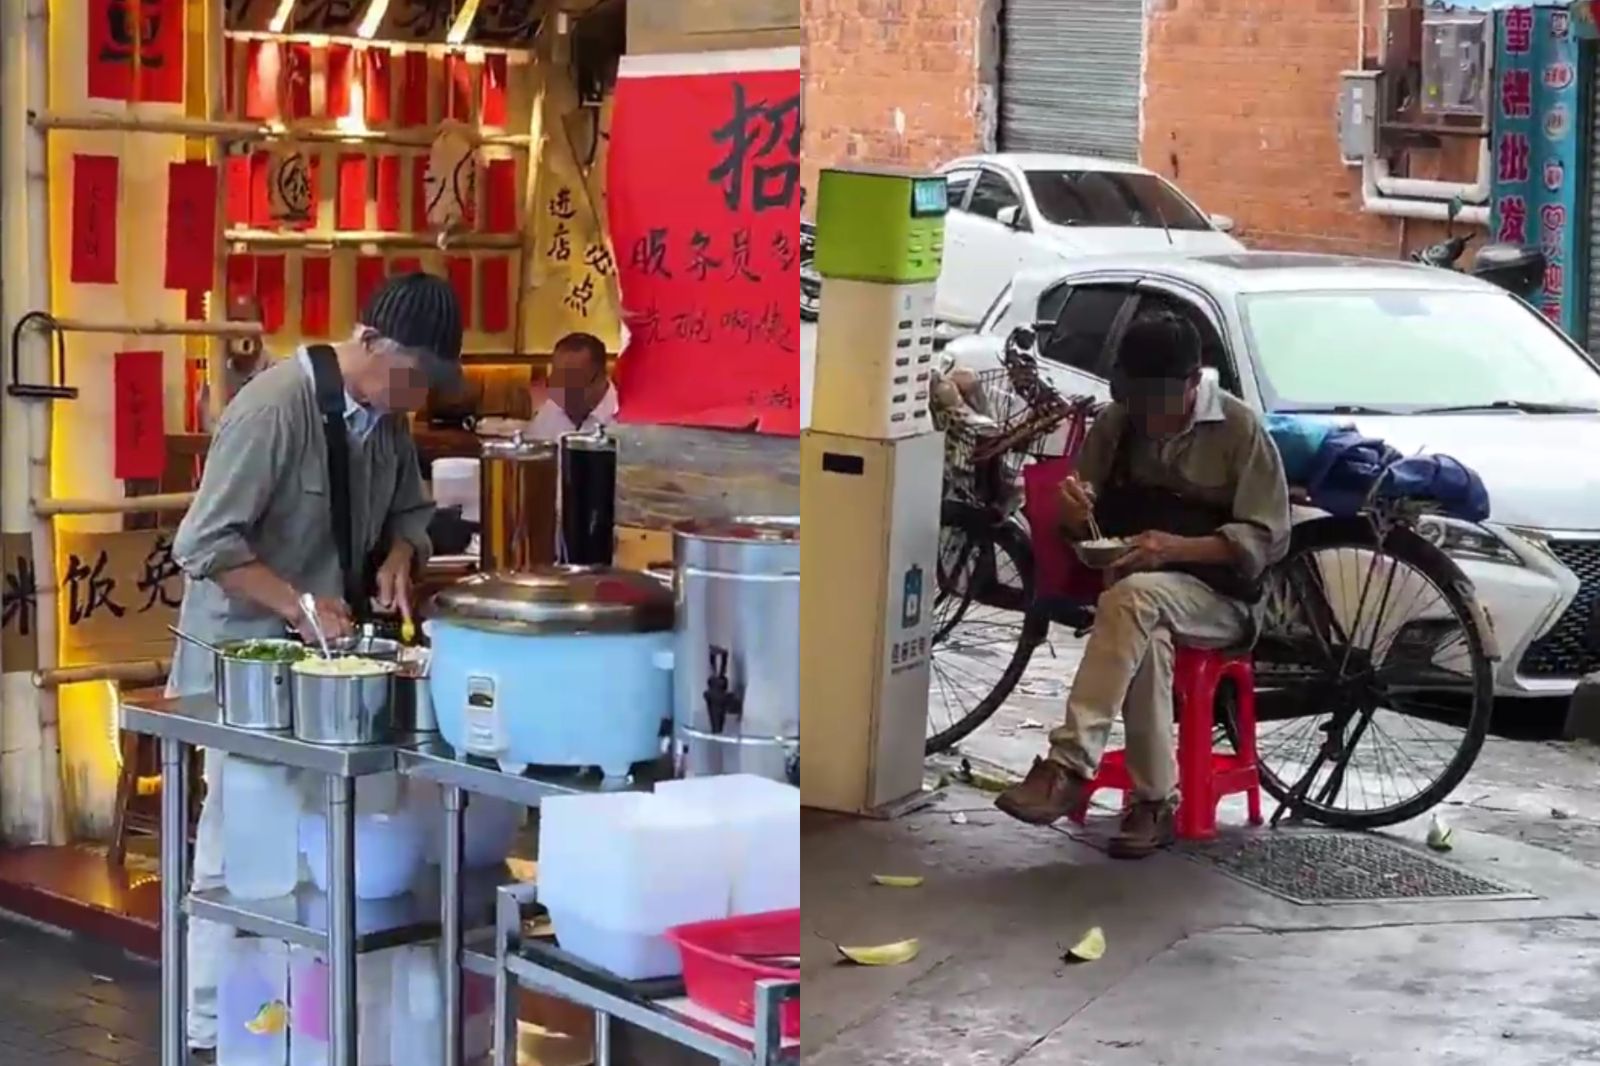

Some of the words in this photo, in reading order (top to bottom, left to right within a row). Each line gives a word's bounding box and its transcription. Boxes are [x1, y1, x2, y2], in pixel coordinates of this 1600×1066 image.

[708, 81, 799, 212] 招
[547, 186, 576, 261] 进店
[564, 244, 616, 317] 必点
